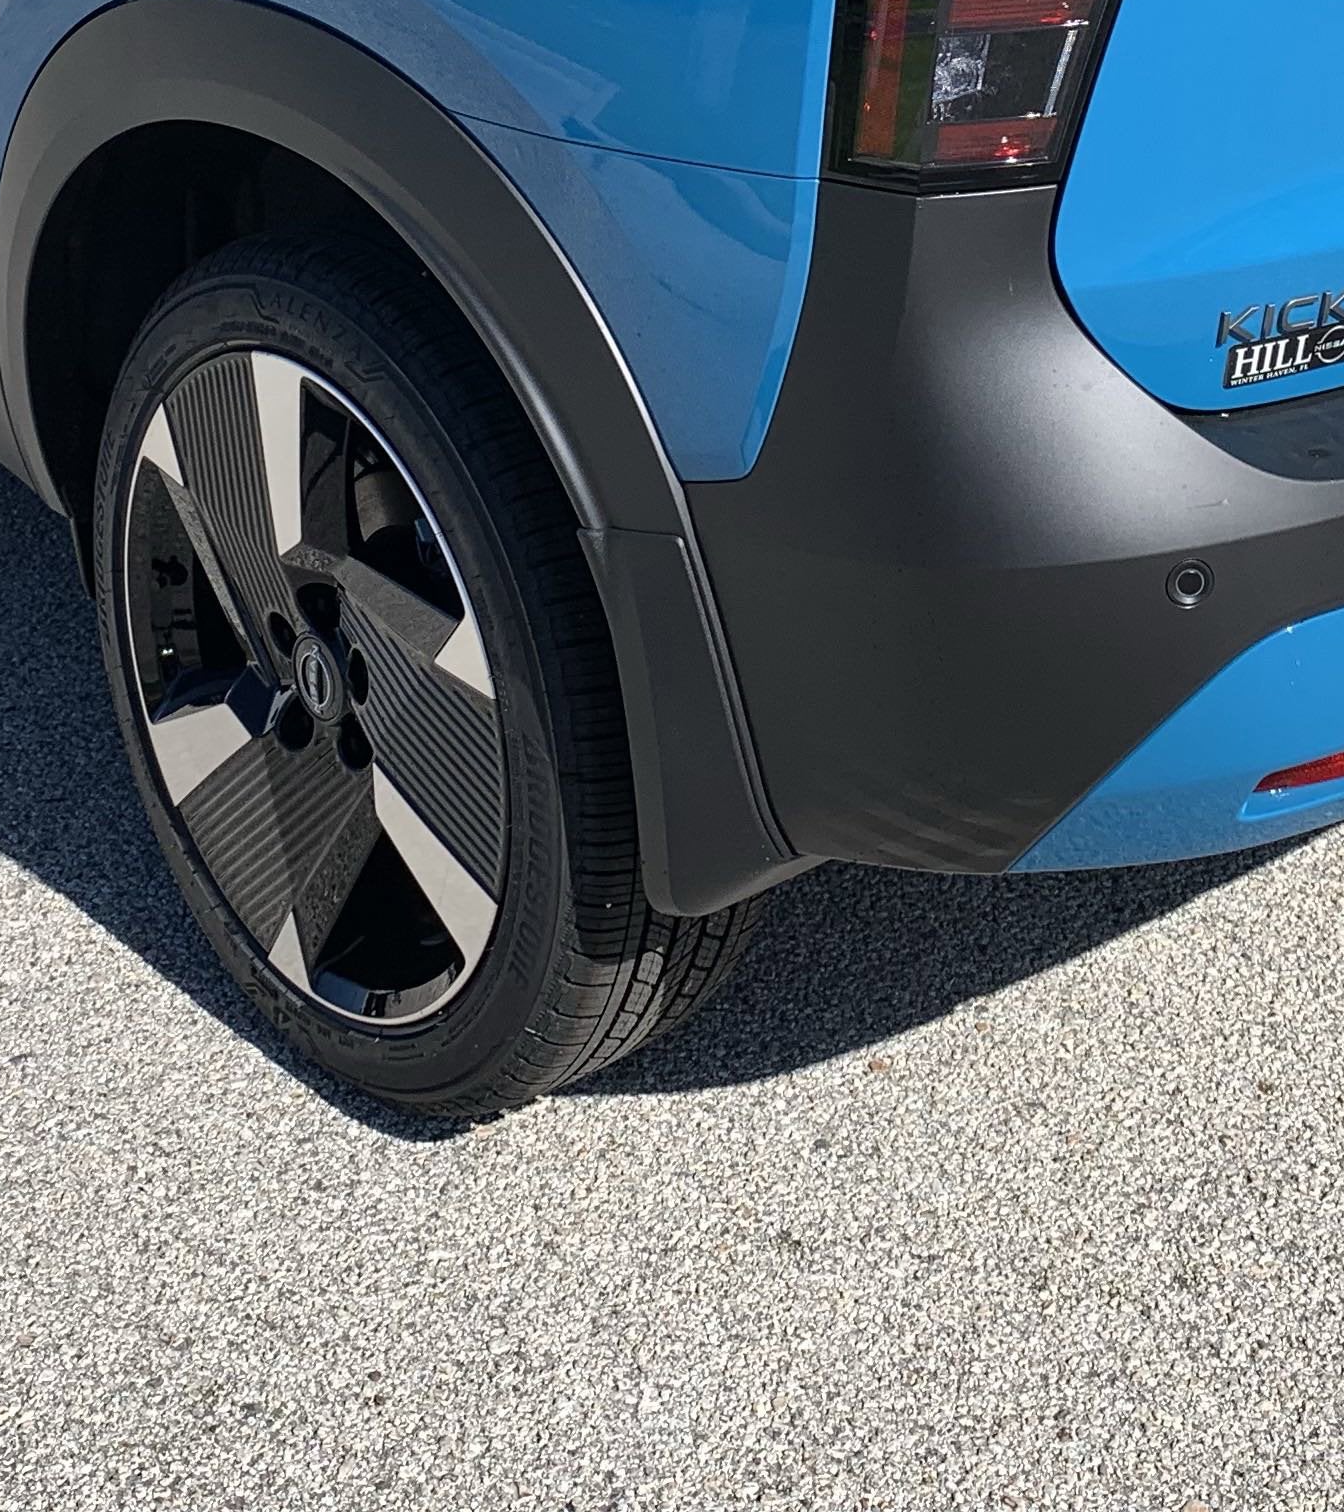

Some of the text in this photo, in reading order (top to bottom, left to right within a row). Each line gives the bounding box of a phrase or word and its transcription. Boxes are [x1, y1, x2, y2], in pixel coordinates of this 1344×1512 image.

[1231, 334, 1312, 378] HILL
[1230, 374, 1264, 386] WINTER
[1266, 366, 1298, 379] HAVEN,
